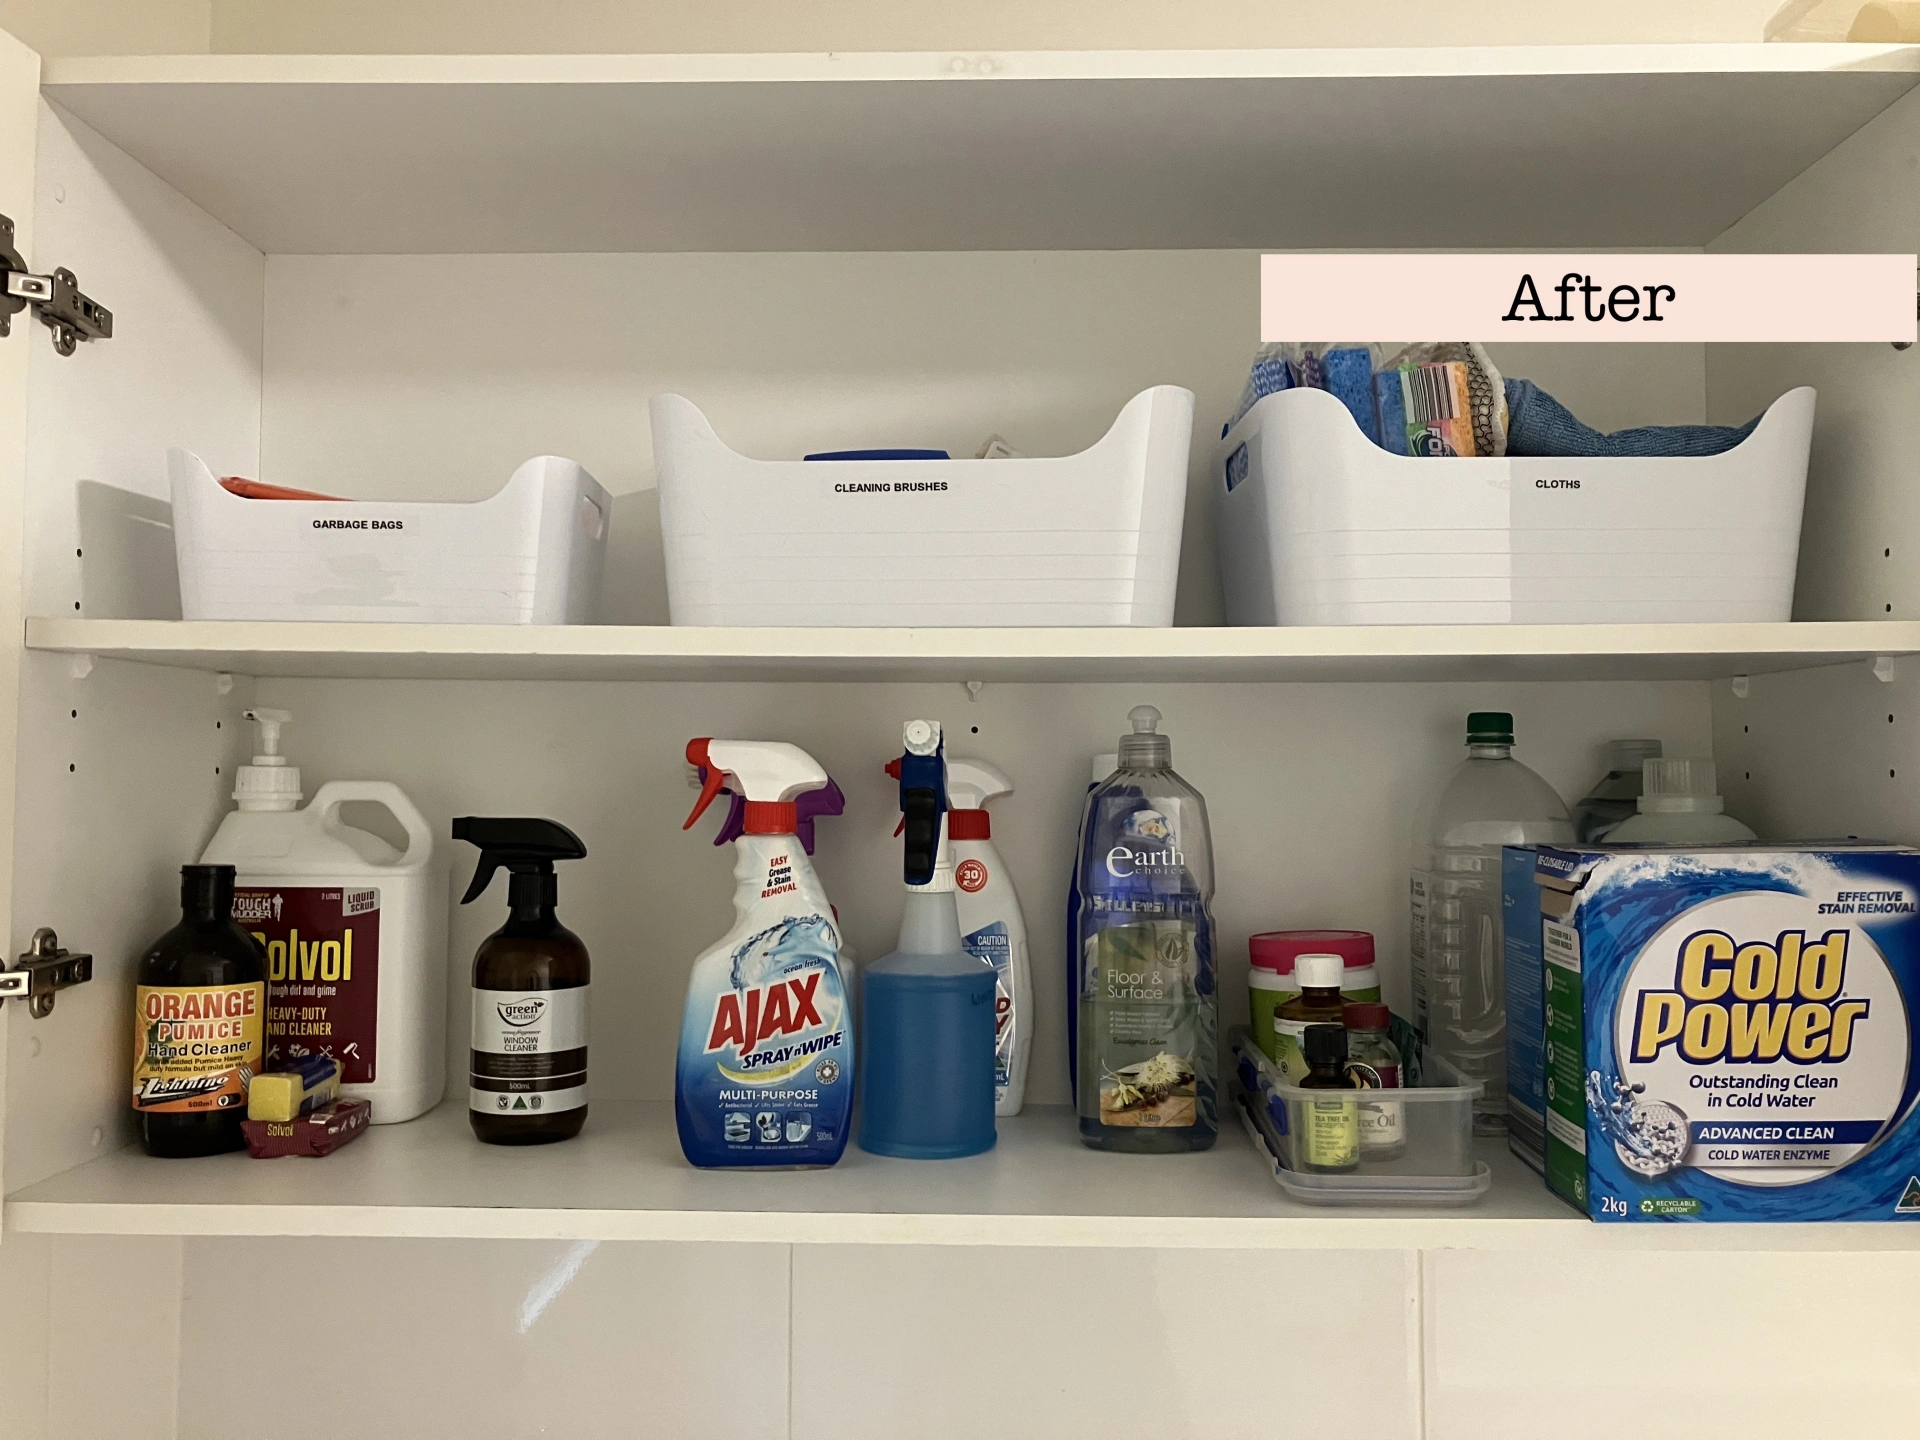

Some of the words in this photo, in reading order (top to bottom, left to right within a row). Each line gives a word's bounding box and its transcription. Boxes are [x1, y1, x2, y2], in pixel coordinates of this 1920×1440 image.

[834, 483, 891, 493] CLEANING
[894, 481, 948, 492] BRUSHES
[1535, 479, 1581, 489] CLOTHS
[312, 519, 368, 530] GARBAGE
[371, 519, 404, 530] BAGS
[770, 855, 788, 867] EASY
[1106, 846, 1185, 878] earth
[1564, 861, 1574, 872] LID
[768, 866, 791, 877] Grease
[964, 869, 979, 880] 30
[1135, 866, 1185, 875] choice
[766, 879, 773, 887] &
[774, 875, 791, 886] Stain
[347, 890, 375, 904] LIQUID
[761, 883, 797, 898] REMOVAL
[1837, 891, 1903, 902] EFFECTIVE
[232, 897, 271, 910] TOUGH
[350, 901, 375, 913] SCRUB
[1818, 903, 1856, 914] STAIN
[1858, 902, 1917, 914] REMOVAL
[230, 909, 272, 919] MUDDER
[977, 935, 1007, 946] CAUTION
[251, 929, 352, 981] olvol
[783, 962, 803, 974] ocean
[804, 957, 821, 968] fresh
[1678, 930, 1849, 1001] Cold
[1107, 969, 1145, 985] Floor
[1151, 971, 1163, 985] &
[303, 985, 316, 996] and
[317, 985, 336, 998] grime
[1107, 984, 1163, 999] Surface
[145, 989, 256, 1020] ORANGE
[505, 1004, 538, 1017] green
[708, 973, 822, 1057] AJAX
[158, 1020, 242, 1041] PUMICE
[288, 1022, 332, 1036] CLEANER
[1632, 990, 1869, 1063] Power
[503, 1036, 539, 1044] WINDOW
[147, 1043, 188, 1057] Hand
[191, 1040, 252, 1056] Cleaner
[743, 1045, 794, 1069] SPRAY
[800, 1032, 842, 1056] WIPE
[194, 1056, 222, 1065] Pumice
[1689, 1074, 1791, 1091] Outstanding
[1793, 1074, 1838, 1089] Clean
[719, 1089, 818, 1100] MULTI-PURPOSE
[1707, 1093, 1722, 1107] in
[1725, 1093, 1763, 1107] Cold
[1766, 1093, 1816, 1107] Water
[1357, 1116, 1375, 1128] ree
[1377, 1113, 1396, 1128] Oil
[267, 1123, 294, 1137] Solvol
[816, 1131, 833, 1141] 500mL
[1699, 1127, 1783, 1140] ADVANCED
[1785, 1127, 1835, 1139] CLEAN
[1708, 1150, 1739, 1160] COLD
[1741, 1150, 1781, 1160] WATER
[1783, 1149, 1830, 1160] ENZYME
[1601, 1196, 1628, 1217] 2kg
